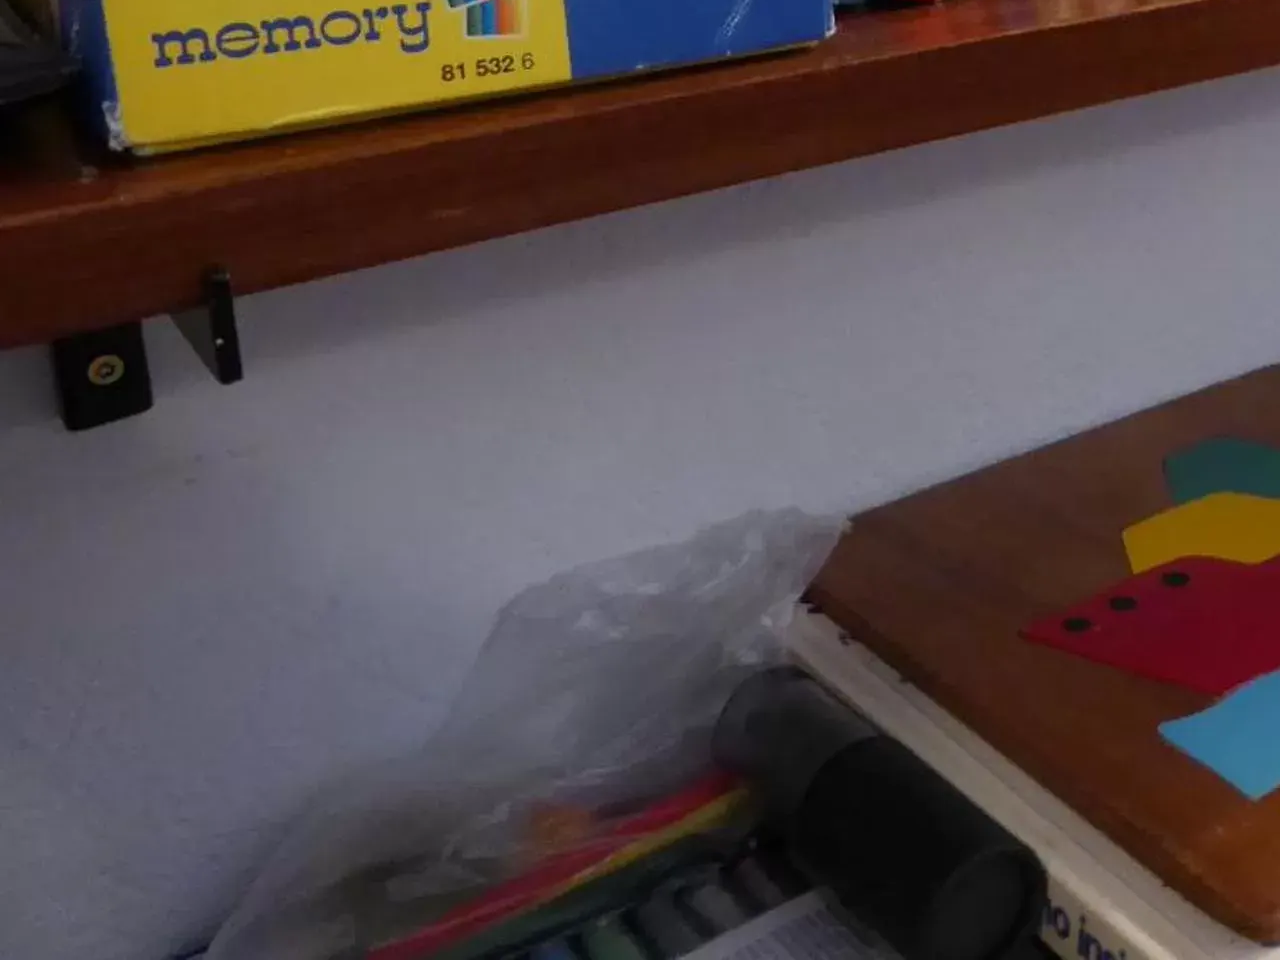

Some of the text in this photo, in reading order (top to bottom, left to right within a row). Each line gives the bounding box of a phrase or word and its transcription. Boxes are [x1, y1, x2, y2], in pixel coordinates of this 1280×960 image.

[441, 51, 535, 83] 81 532 6
